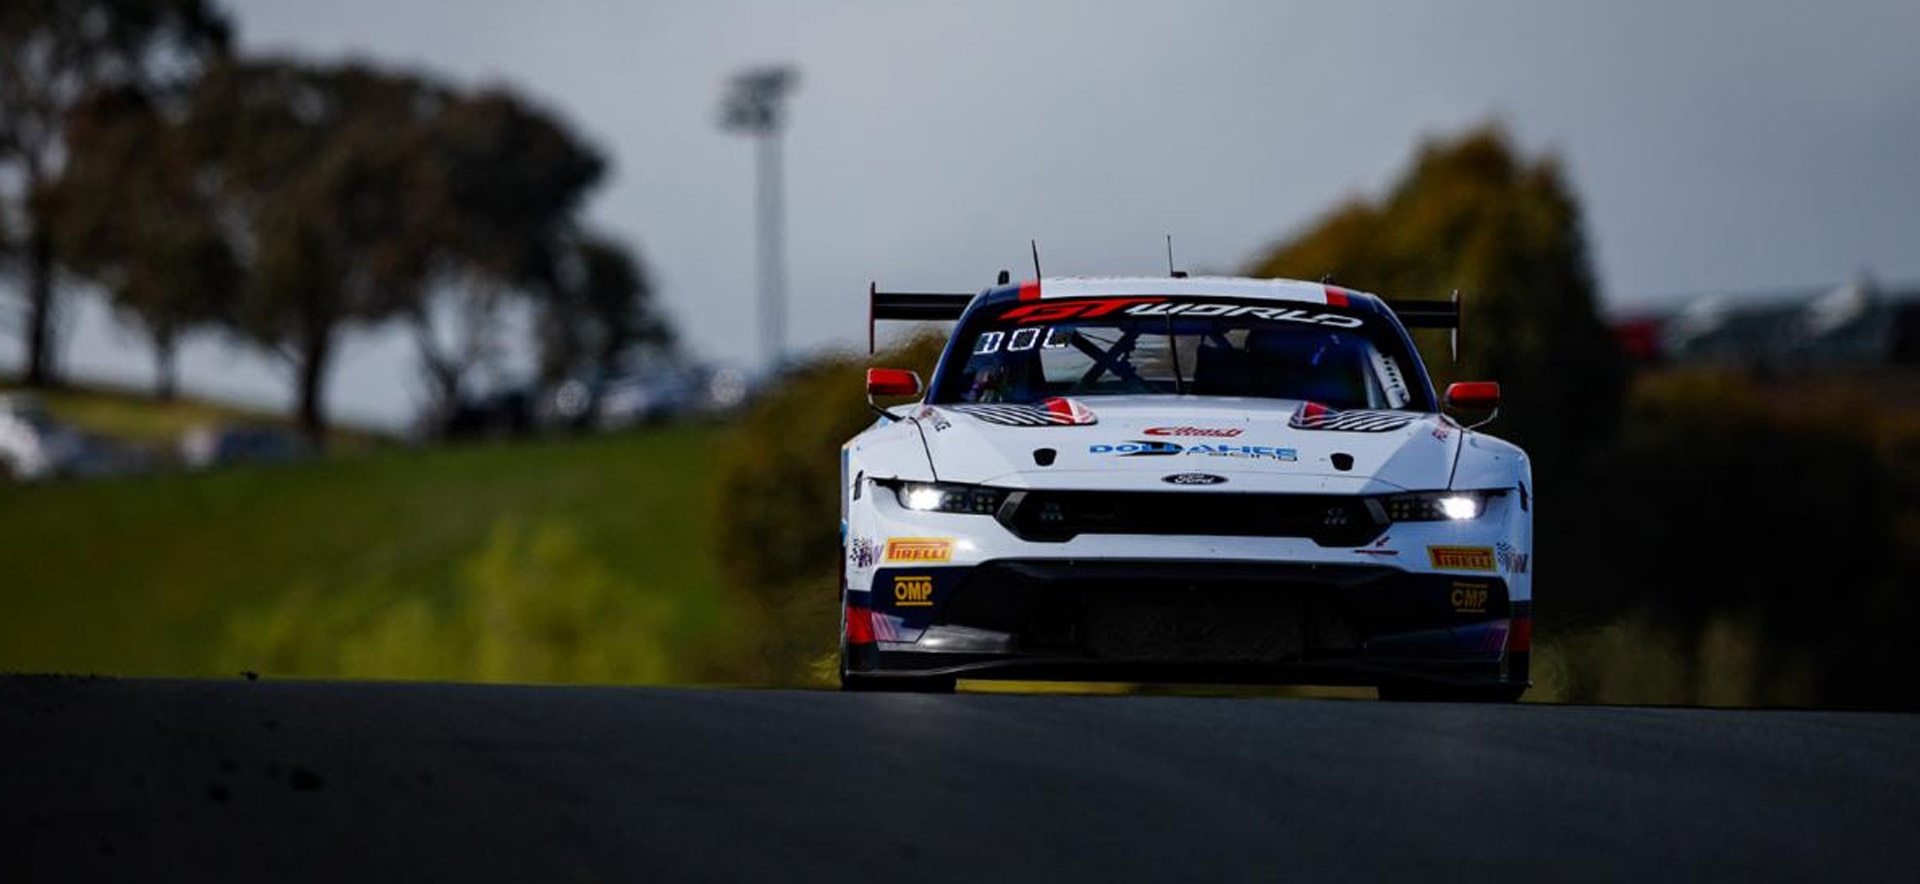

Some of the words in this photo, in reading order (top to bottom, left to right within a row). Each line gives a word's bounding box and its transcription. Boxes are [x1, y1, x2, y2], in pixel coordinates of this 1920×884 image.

[1124, 302, 1364, 328] WORLD
[888, 541, 949, 560] PIRELLI
[895, 582, 932, 600] OMP
